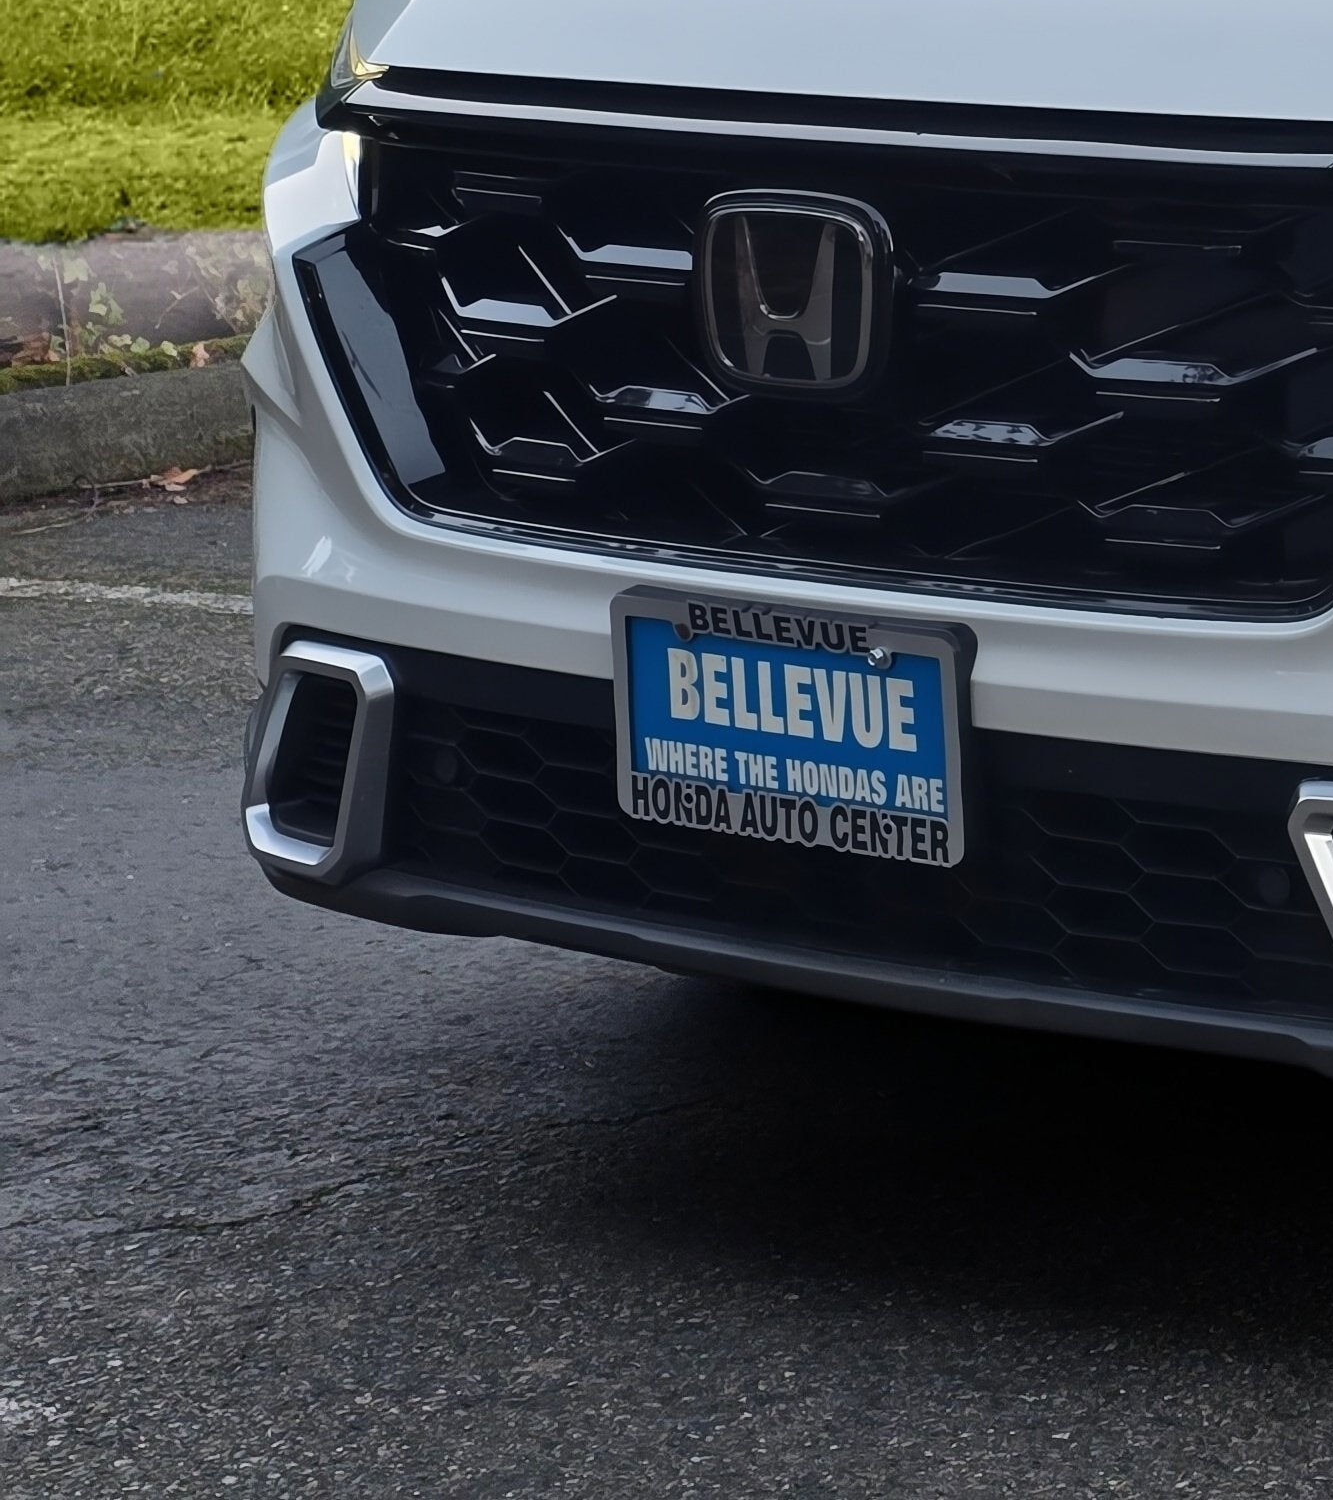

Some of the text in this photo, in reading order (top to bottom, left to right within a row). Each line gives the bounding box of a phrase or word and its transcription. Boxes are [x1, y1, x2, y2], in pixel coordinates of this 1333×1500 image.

[687, 602, 870, 653] BELLEVUE
[666, 647, 918, 753] BELLEVUE
[644, 737, 945, 814] WHERE THE HONDAS ARE
[631, 775, 950, 864] HONDA AUTO CENTER
